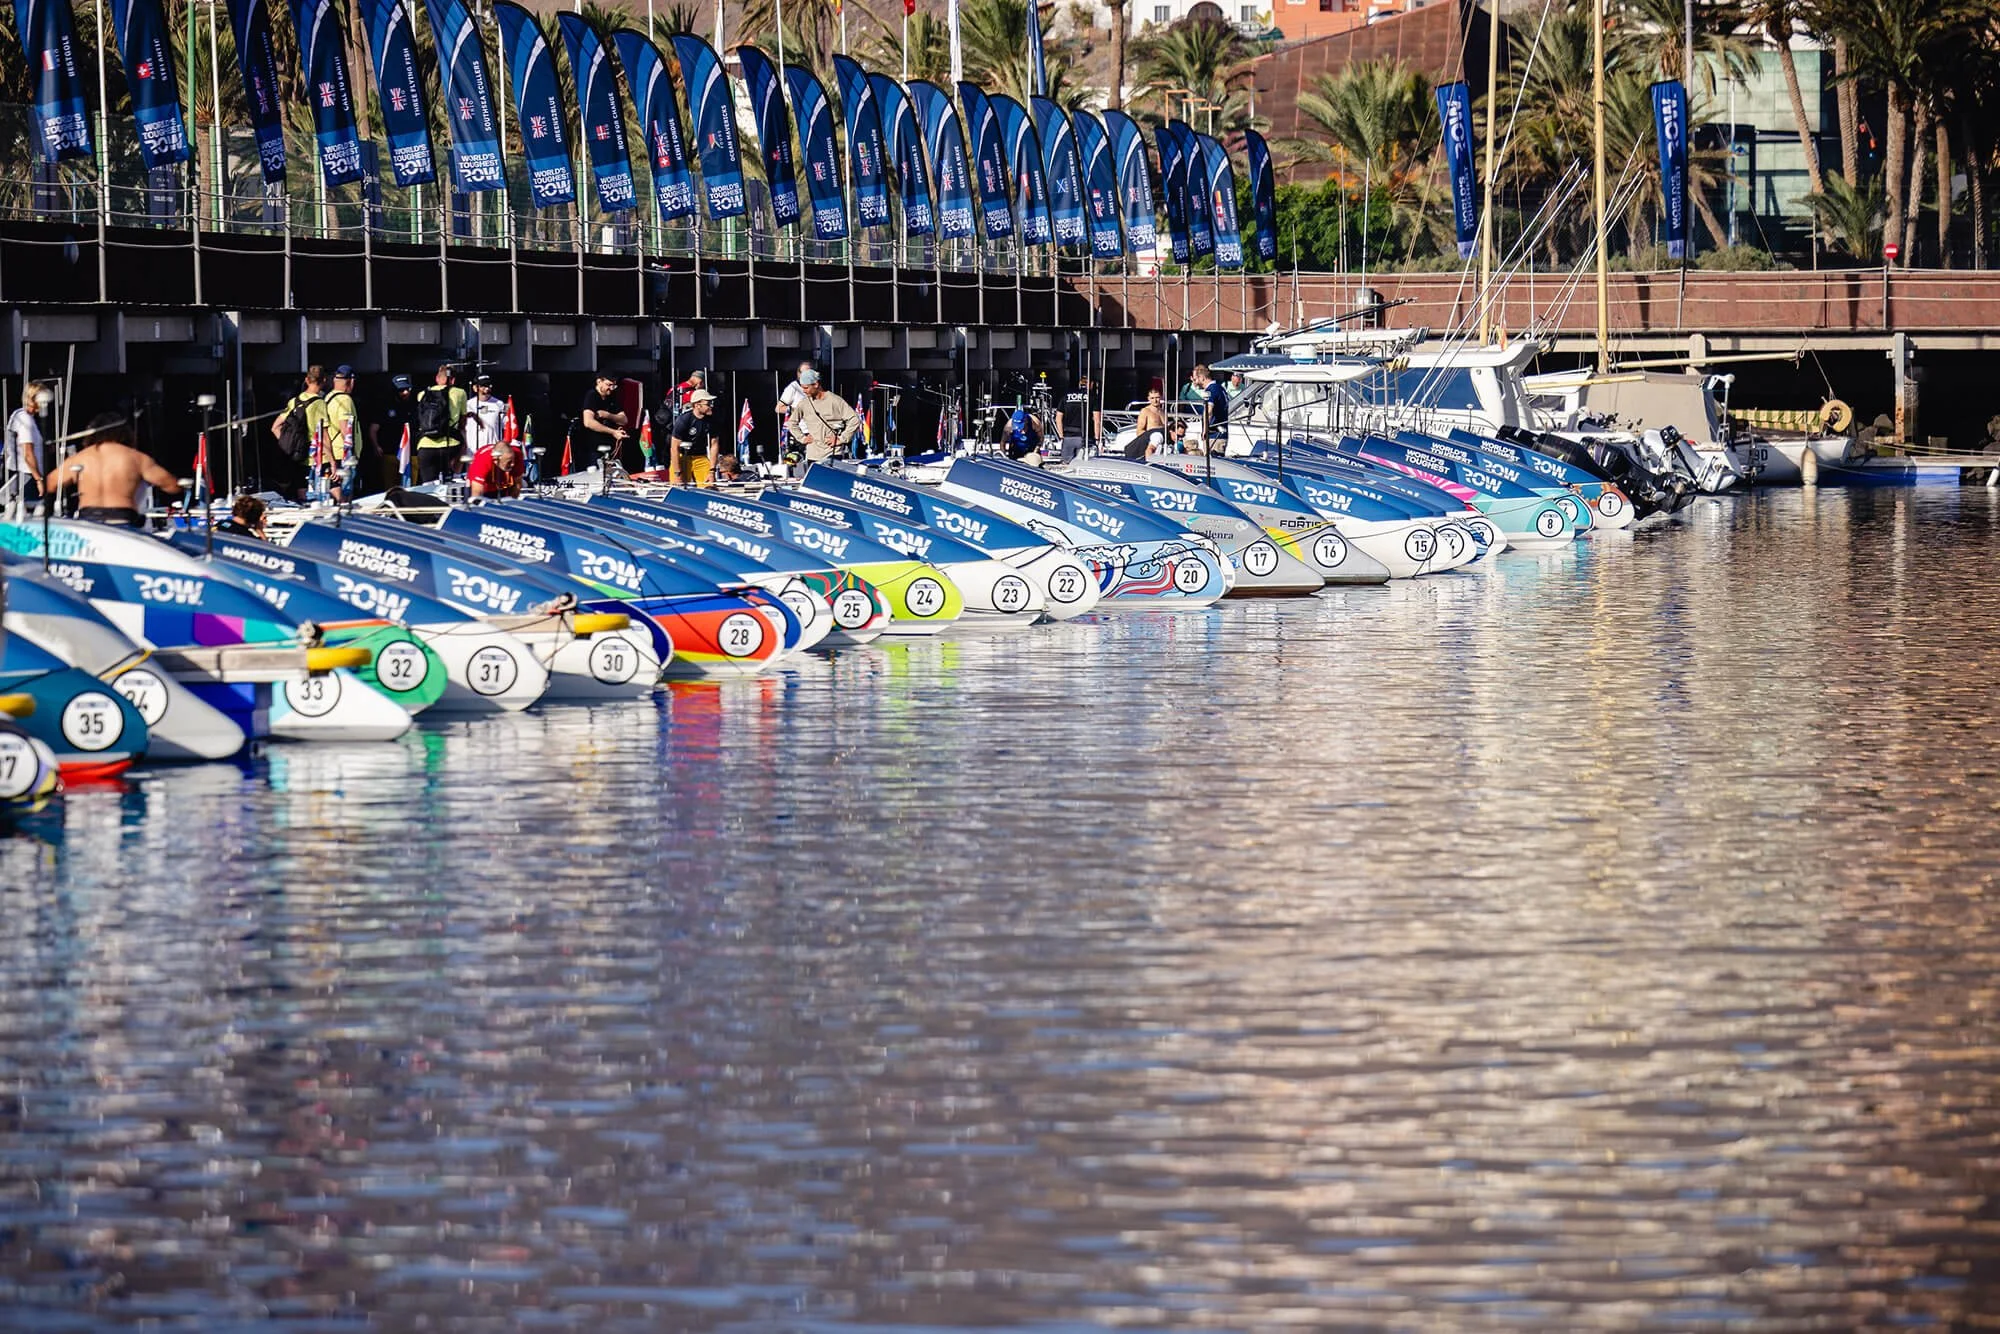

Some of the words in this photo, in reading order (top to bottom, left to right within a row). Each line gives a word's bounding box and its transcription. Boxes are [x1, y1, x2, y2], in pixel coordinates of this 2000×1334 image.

[403, 48, 412, 65] FISH
[334, 56, 344, 80] EARTH
[405, 66, 416, 92] FLYING
[473, 60, 485, 94] SCULLERS
[340, 93, 349, 111] CALL
[411, 93, 421, 116] THREE
[608, 92, 619, 119] CHANGE
[481, 96, 492, 131] SOUTHSEA
[548, 96, 562, 143] GREENS2BLUE
[721, 105, 732, 139] MAVERICKS
[669, 118, 679, 143] FONDUE
[617, 134, 625, 150] ROW
[674, 144, 682, 161] KIWI
[728, 140, 736, 162] OCEAN
[459, 160, 498, 168] TOUGHEST
[461, 153, 495, 162] WORLD'S
[533, 173, 569, 185] TOUGHEST
[534, 167, 566, 178] WORLD'S
[600, 173, 629, 184] WORLD'S
[600, 179, 631, 190] TOUGHEST
[709, 188, 742, 200] TOUGHEST
[711, 183, 740, 194] WORLD'S
[1459, 176, 1470, 229] WORLD'S
[1406, 449, 1445, 466] WORLD'S
[1431, 442, 1467, 458] WORLD'S
[1481, 440, 1515, 455] WORLD'S
[1405, 455, 1450, 474] TOUGHEST
[1001, 477, 1052, 499] WORLD'S
[1462, 467, 1503, 493] ROW
[850, 488, 913, 515] TOUGHEST
[853, 481, 906, 503] WORLD'S
[1000, 485, 1059, 510] TOUGHEST
[1145, 490, 1198, 512] ROW
[1228, 482, 1278, 504] ROW
[1304, 486, 1352, 512] ROW
[705, 509, 773, 533] TOUGHEST
[708, 500, 764, 521] WORLD'S
[790, 500, 845, 521] WORLD'S
[1073, 501, 1126, 538] ROW
[932, 506, 989, 543] ROW
[1547, 518, 1553, 529] 8
[481, 524, 546, 548] WORLD'S
[789, 521, 849, 559] ROW
[1415, 540, 1428, 553] 15
[341, 539, 411, 566] WORLD'S
[478, 533, 555, 563] TOUGHEST
[1324, 545, 1337, 558] 16
[222, 546, 295, 573] WORLD'S
[337, 550, 419, 581] TOUGHEST
[576, 549, 647, 591] ROW
[1254, 553, 1267, 566] 17
[1059, 579, 1075, 593] 22
[1183, 570, 1198, 584] 20
[134, 573, 204, 605] ROW
[333, 574, 411, 621] ROW
[447, 568, 522, 613] ROW
[916, 590, 933, 606] 24
[1003, 588, 1018, 604] 23
[843, 603, 860, 618] 25
[731, 629, 749, 646] 28
[391, 659, 412, 677] 32
[480, 664, 500, 682] 31
[603, 654, 623, 672] 30
[300, 680, 323, 700] 33
[79, 713, 104, 735] 35
